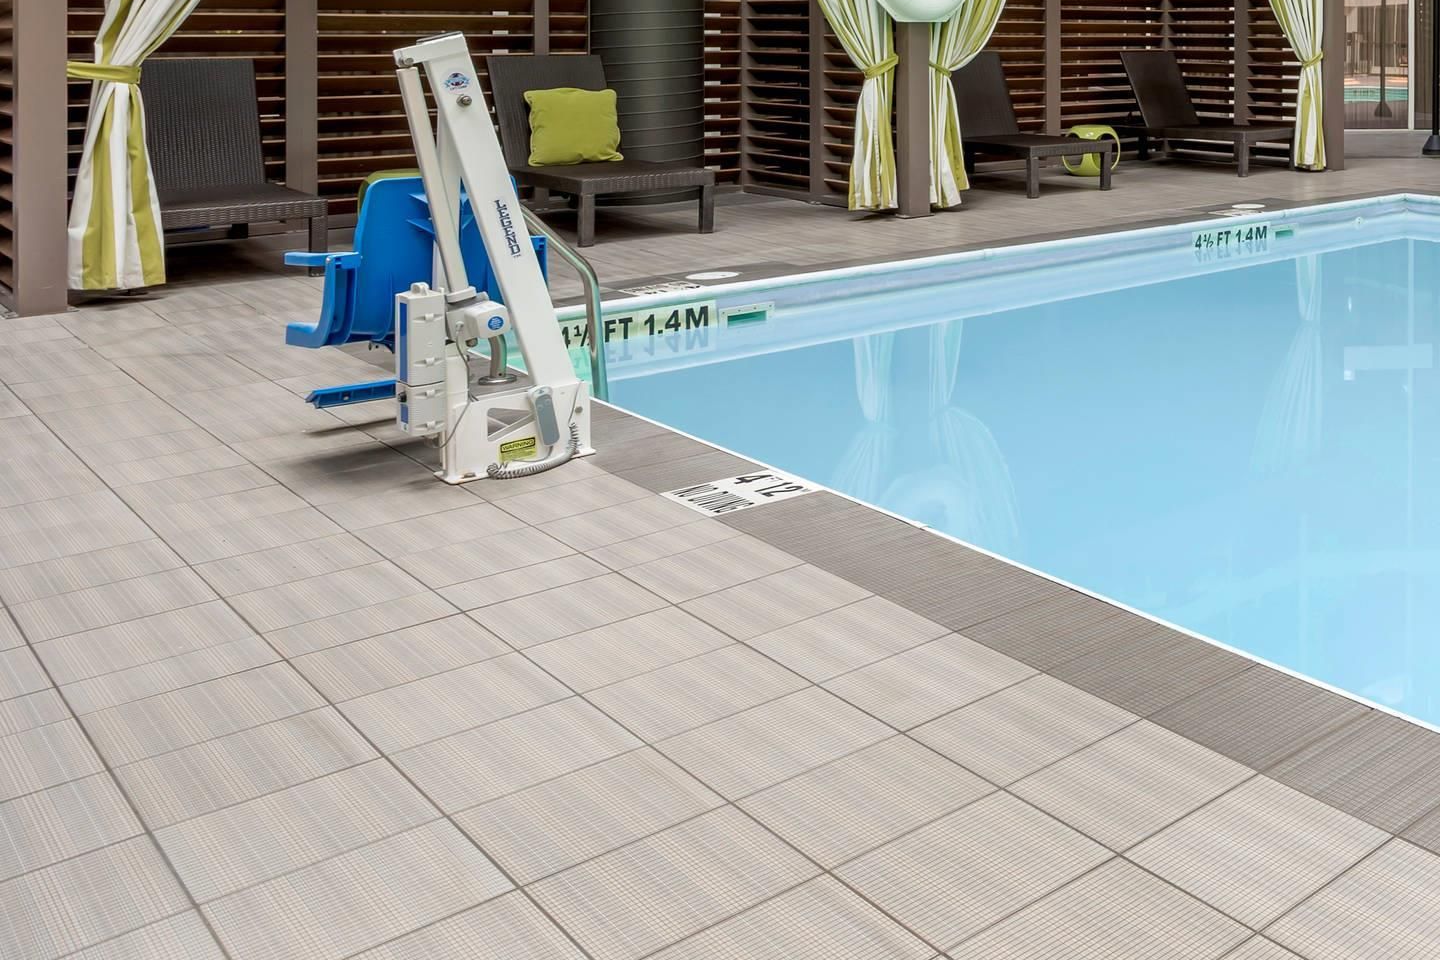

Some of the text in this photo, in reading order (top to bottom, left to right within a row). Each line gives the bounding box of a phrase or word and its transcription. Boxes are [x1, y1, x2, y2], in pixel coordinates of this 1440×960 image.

[494, 200, 521, 255] LEGEND
[1217, 231, 1231, 246] FT
[604, 317, 633, 342] FT
[670, 483, 755, 513] NO DIVING
